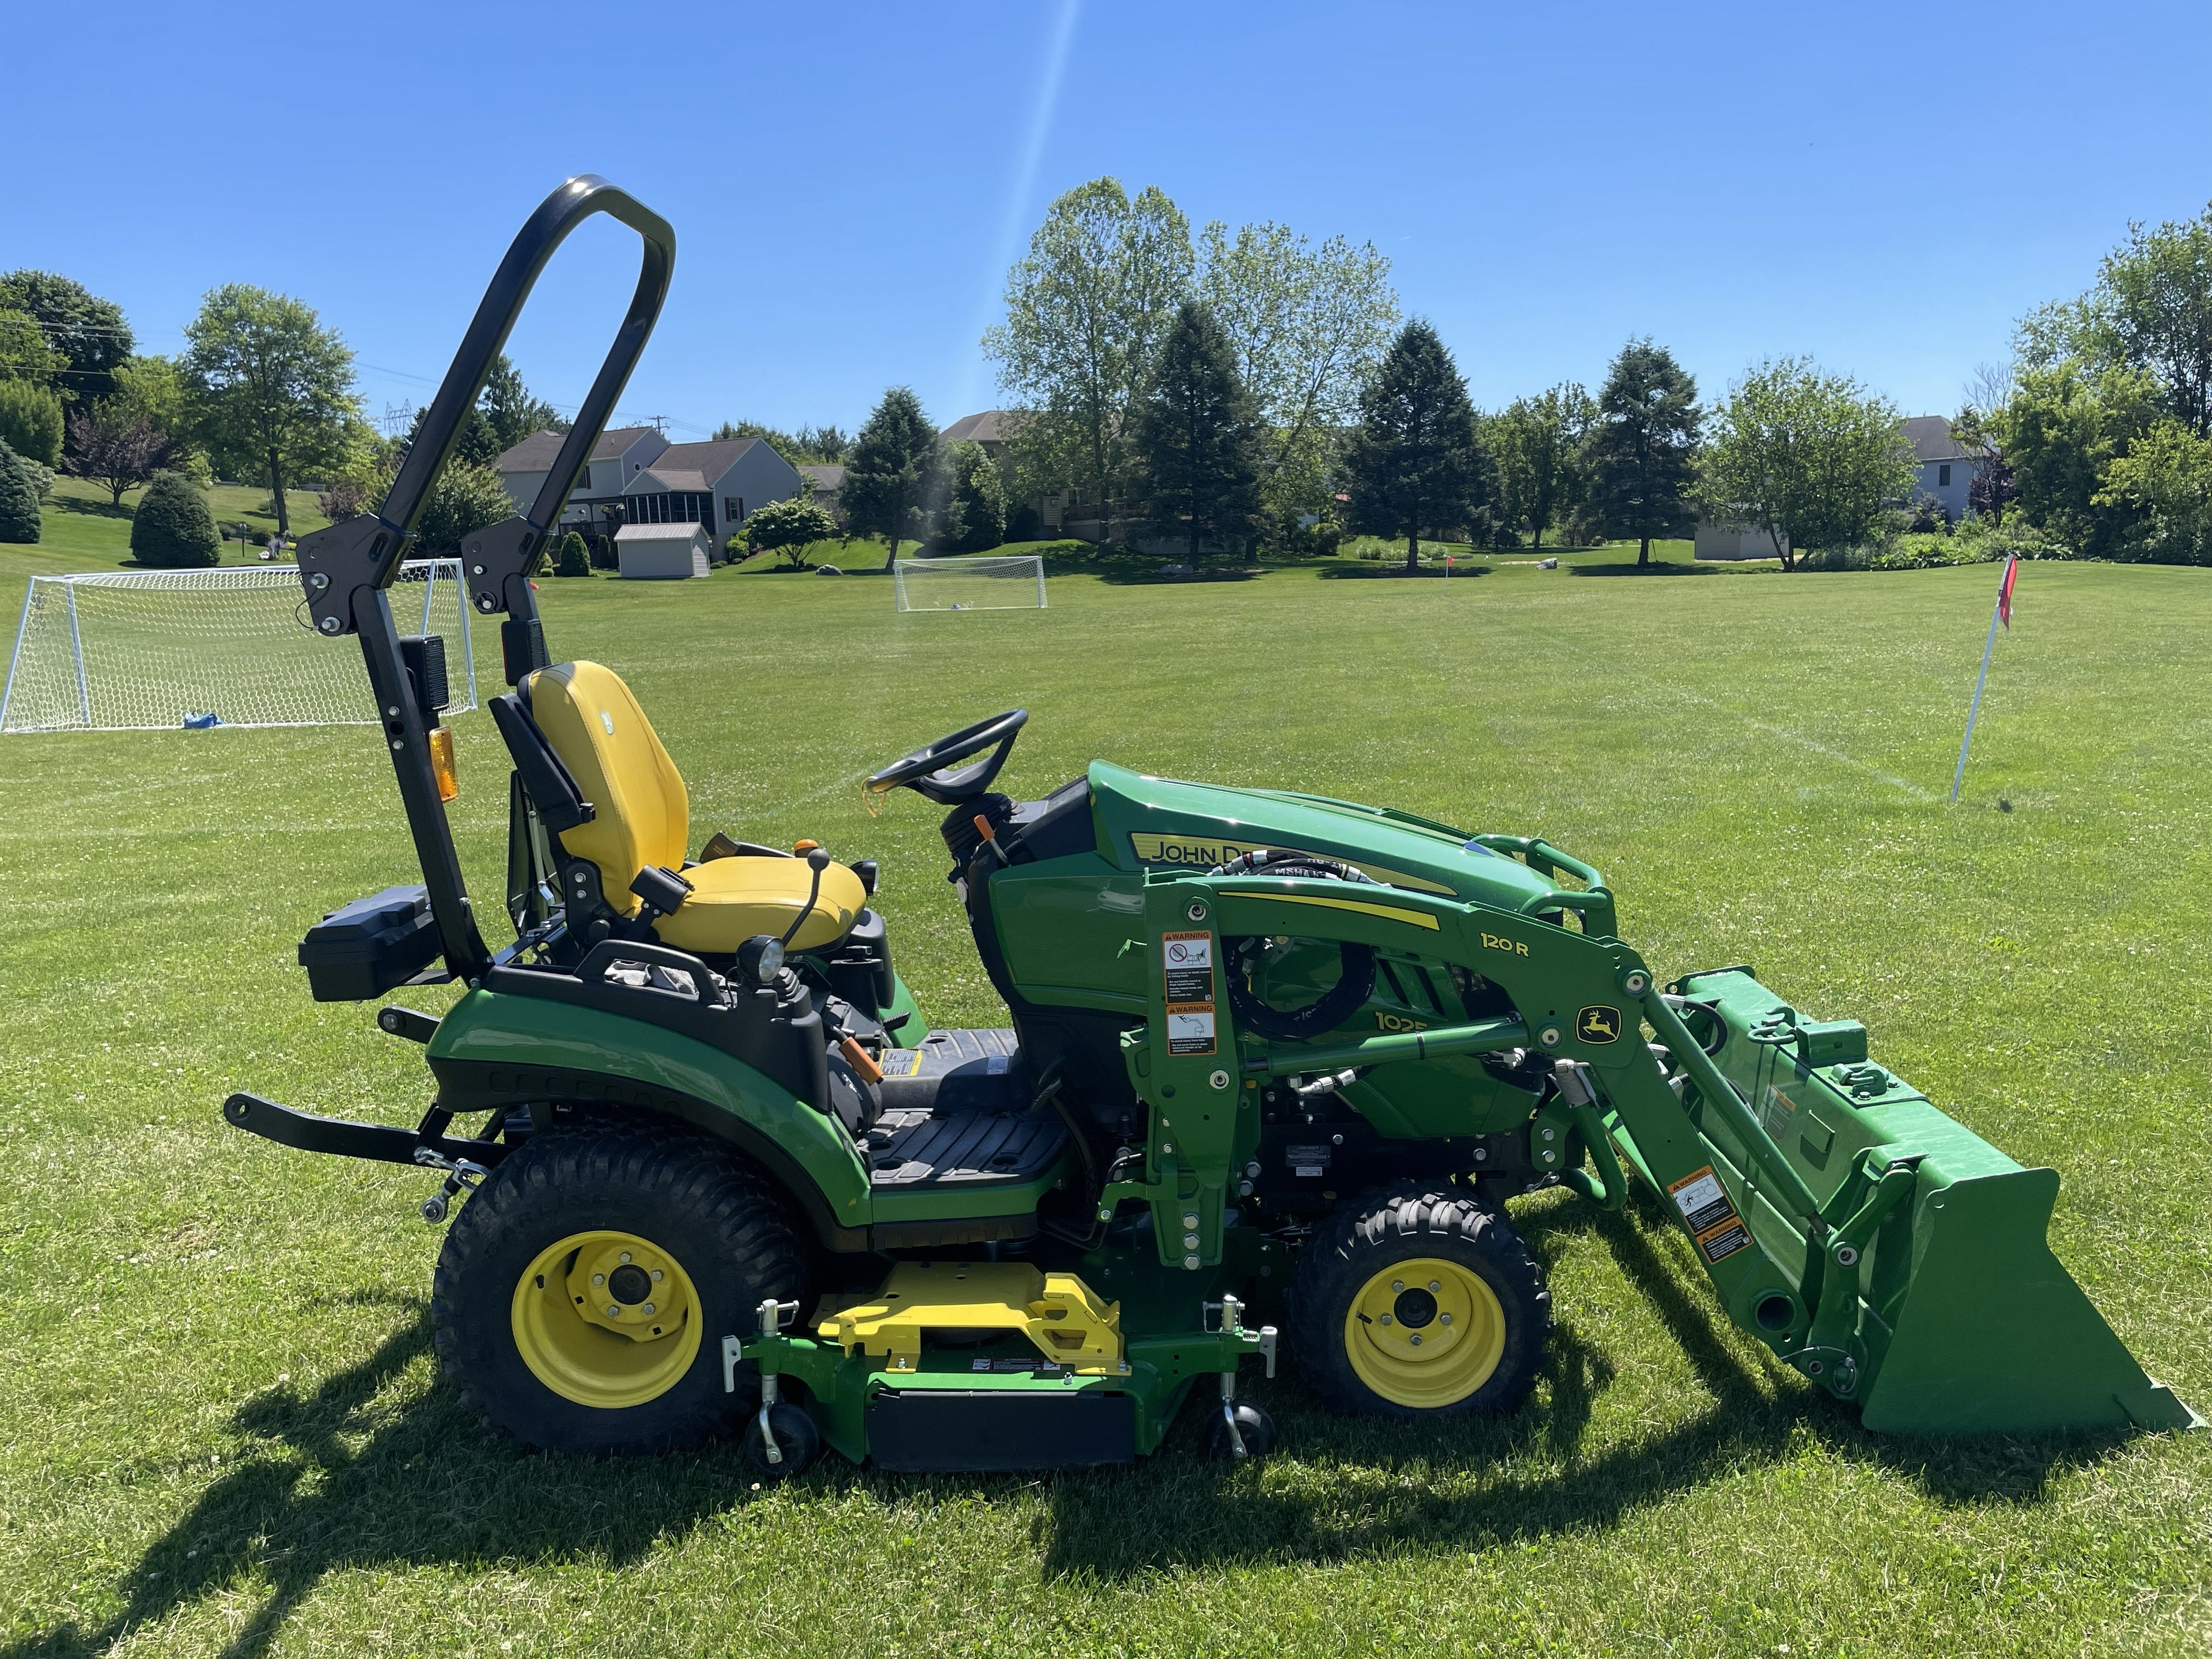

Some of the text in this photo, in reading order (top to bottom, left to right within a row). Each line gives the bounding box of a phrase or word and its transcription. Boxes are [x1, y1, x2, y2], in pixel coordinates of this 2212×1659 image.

[1152, 842, 1216, 862] JOHN
[1172, 931, 1209, 940] WARNING
[1480, 931, 1529, 957] 120 R
[1679, 1170, 1706, 1187] WARNING
[1710, 1221, 1737, 1237] WARNING
